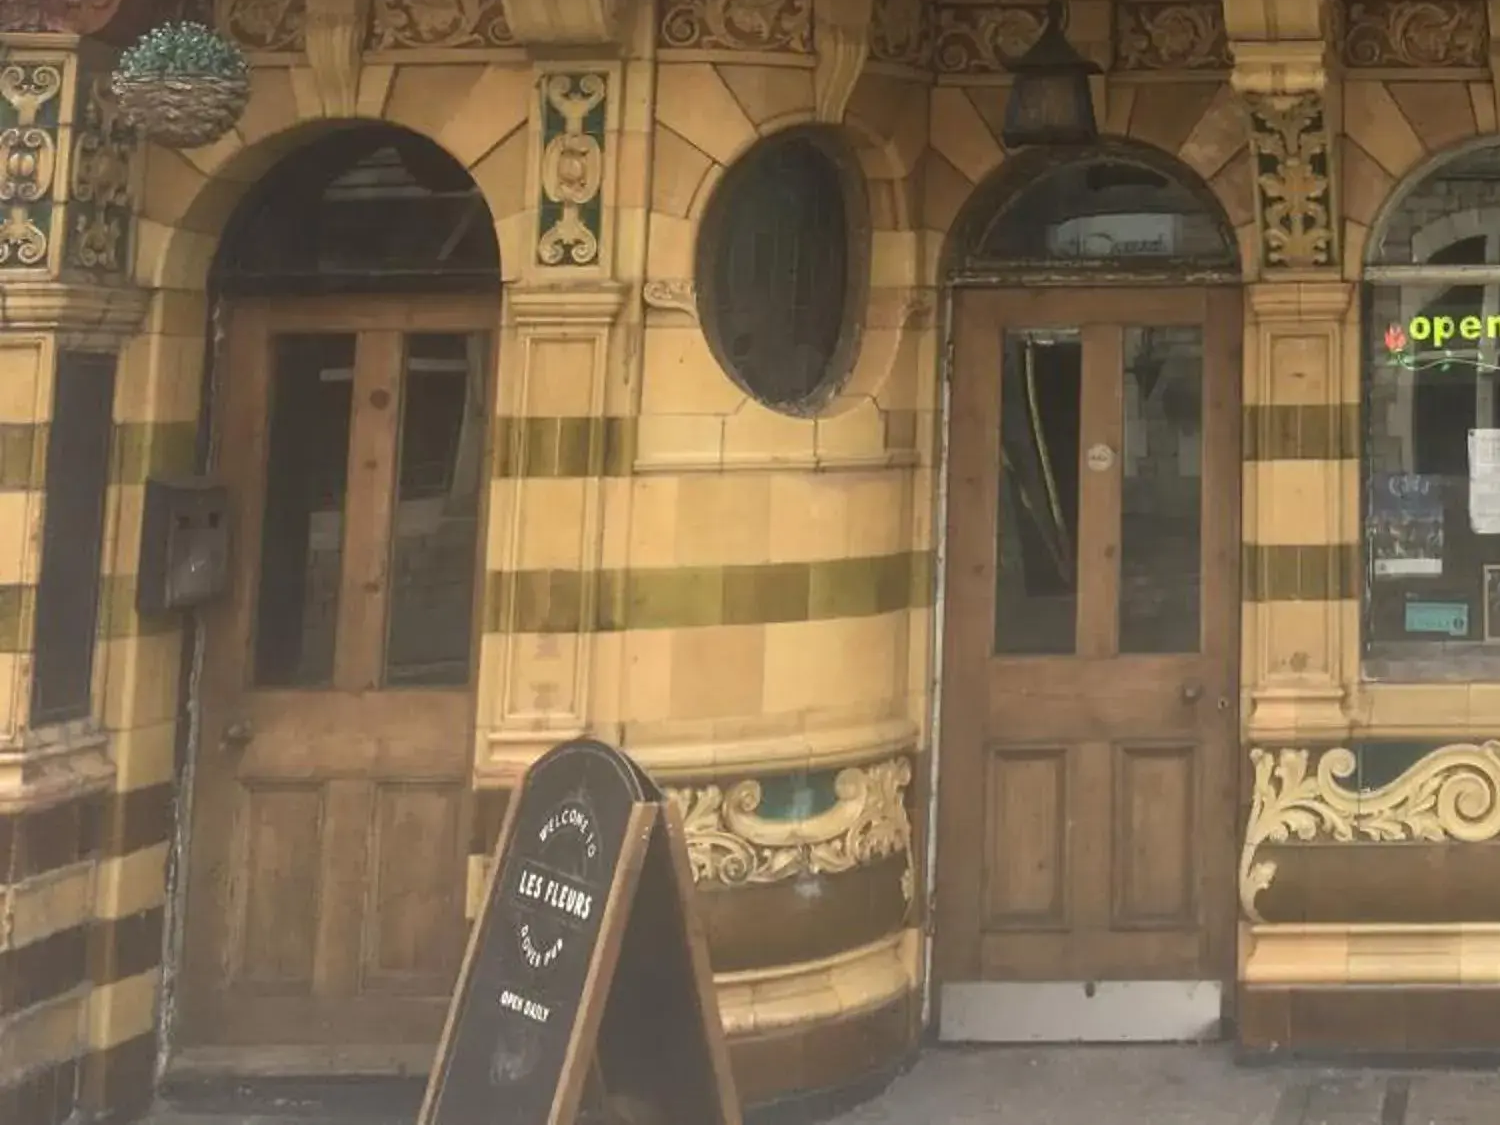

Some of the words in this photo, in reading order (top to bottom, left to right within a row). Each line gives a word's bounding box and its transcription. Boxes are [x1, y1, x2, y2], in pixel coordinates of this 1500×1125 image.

[540, 809, 589, 842] WELCOME
[519, 870, 543, 899] LES
[544, 880, 592, 920] FLEURS
[500, 990, 523, 1012] OPEN
[523, 1000, 550, 1022] DAILY
